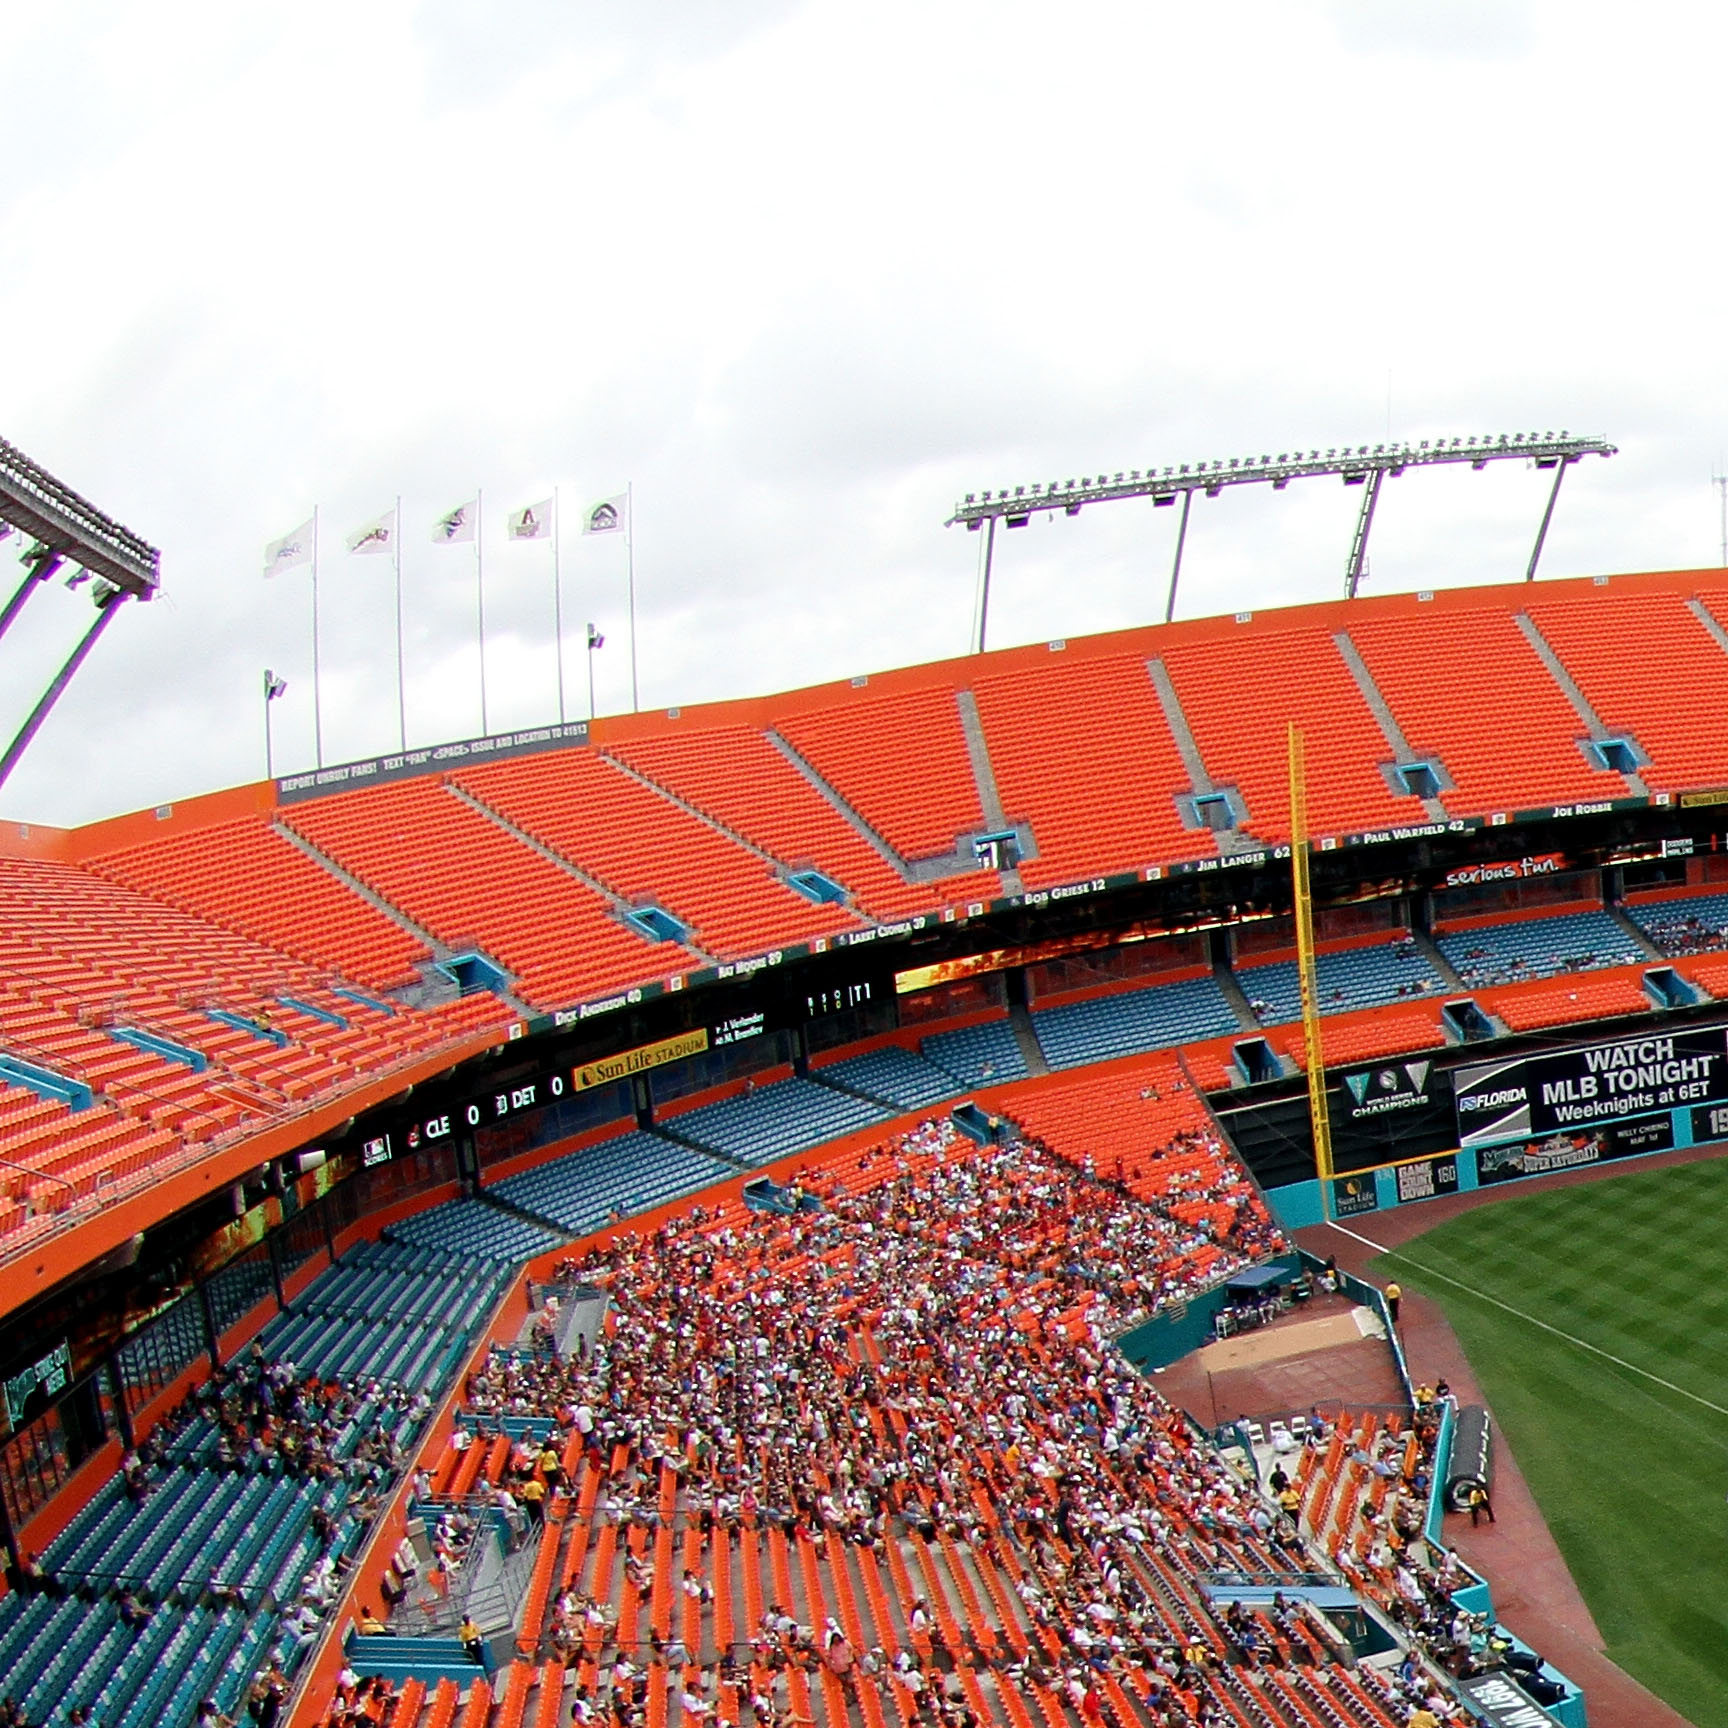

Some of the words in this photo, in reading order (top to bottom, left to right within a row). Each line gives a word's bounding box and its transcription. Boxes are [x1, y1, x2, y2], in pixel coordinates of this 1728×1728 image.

[384, 756, 404, 771] TEXT
[552, 727, 562, 739] TO
[1552, 806, 1573, 818] JOE
[1575, 802, 1612, 816] ROBBIE
[1364, 831, 1391, 844] PAUL
[1392, 823, 1445, 840] WARFIELD
[1449, 819, 1465, 832] 42
[1197, 860, 1218, 872] JIM
[1221, 852, 1266, 868] LANGER
[1274, 846, 1291, 859] 62
[1446, 863, 1516, 887] serious
[1024, 891, 1049, 905] BOB
[1051, 883, 1089, 900] GRIESE
[1092, 879, 1106, 891] 12
[849, 929, 876, 945] LARRY
[913, 916, 926, 929] 39
[595, 1061, 624, 1083] Sun
[627, 1052, 653, 1072] Life
[655, 1038, 705, 1066] STADIUM
[1585, 1038, 1674, 1073] WATCH
[512, 1085, 536, 1109] DET
[551, 1076, 563, 1096] 0
[1542, 1075, 1599, 1106] MLB
[1603, 1055, 1712, 1094] TONIGHT
[1352, 1095, 1429, 1118] CHAMPIONS
[1476, 1087, 1527, 1110] FLORIDA
[1555, 1092, 1655, 1122] Weeknights
[1658, 1087, 1674, 1104] at
[1678, 1080, 1711, 1098] 6ET
[426, 1116, 450, 1138] CLE
[467, 1105, 479, 1124] 0
[1438, 1166, 1455, 1183] 160
[1337, 1196, 1356, 1207] Sun
[1468, 1679, 1513, 1720] 1997
